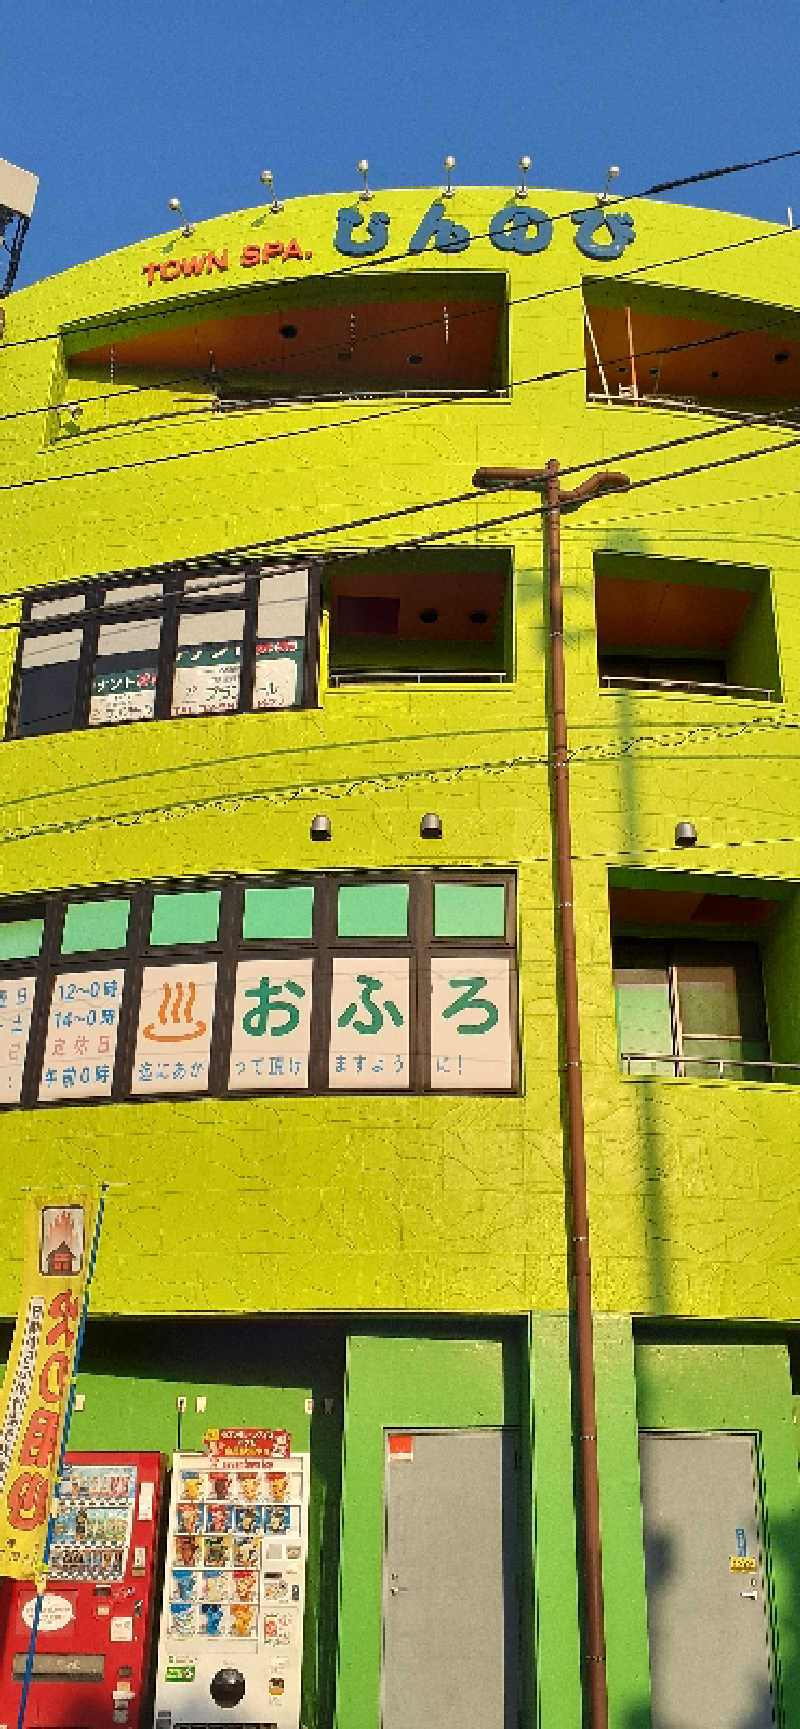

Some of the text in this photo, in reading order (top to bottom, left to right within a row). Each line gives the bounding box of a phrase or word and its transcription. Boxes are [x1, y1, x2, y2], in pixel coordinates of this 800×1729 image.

[142, 249, 229, 287] TOWN
[242, 976, 498, 1036] おふろ
